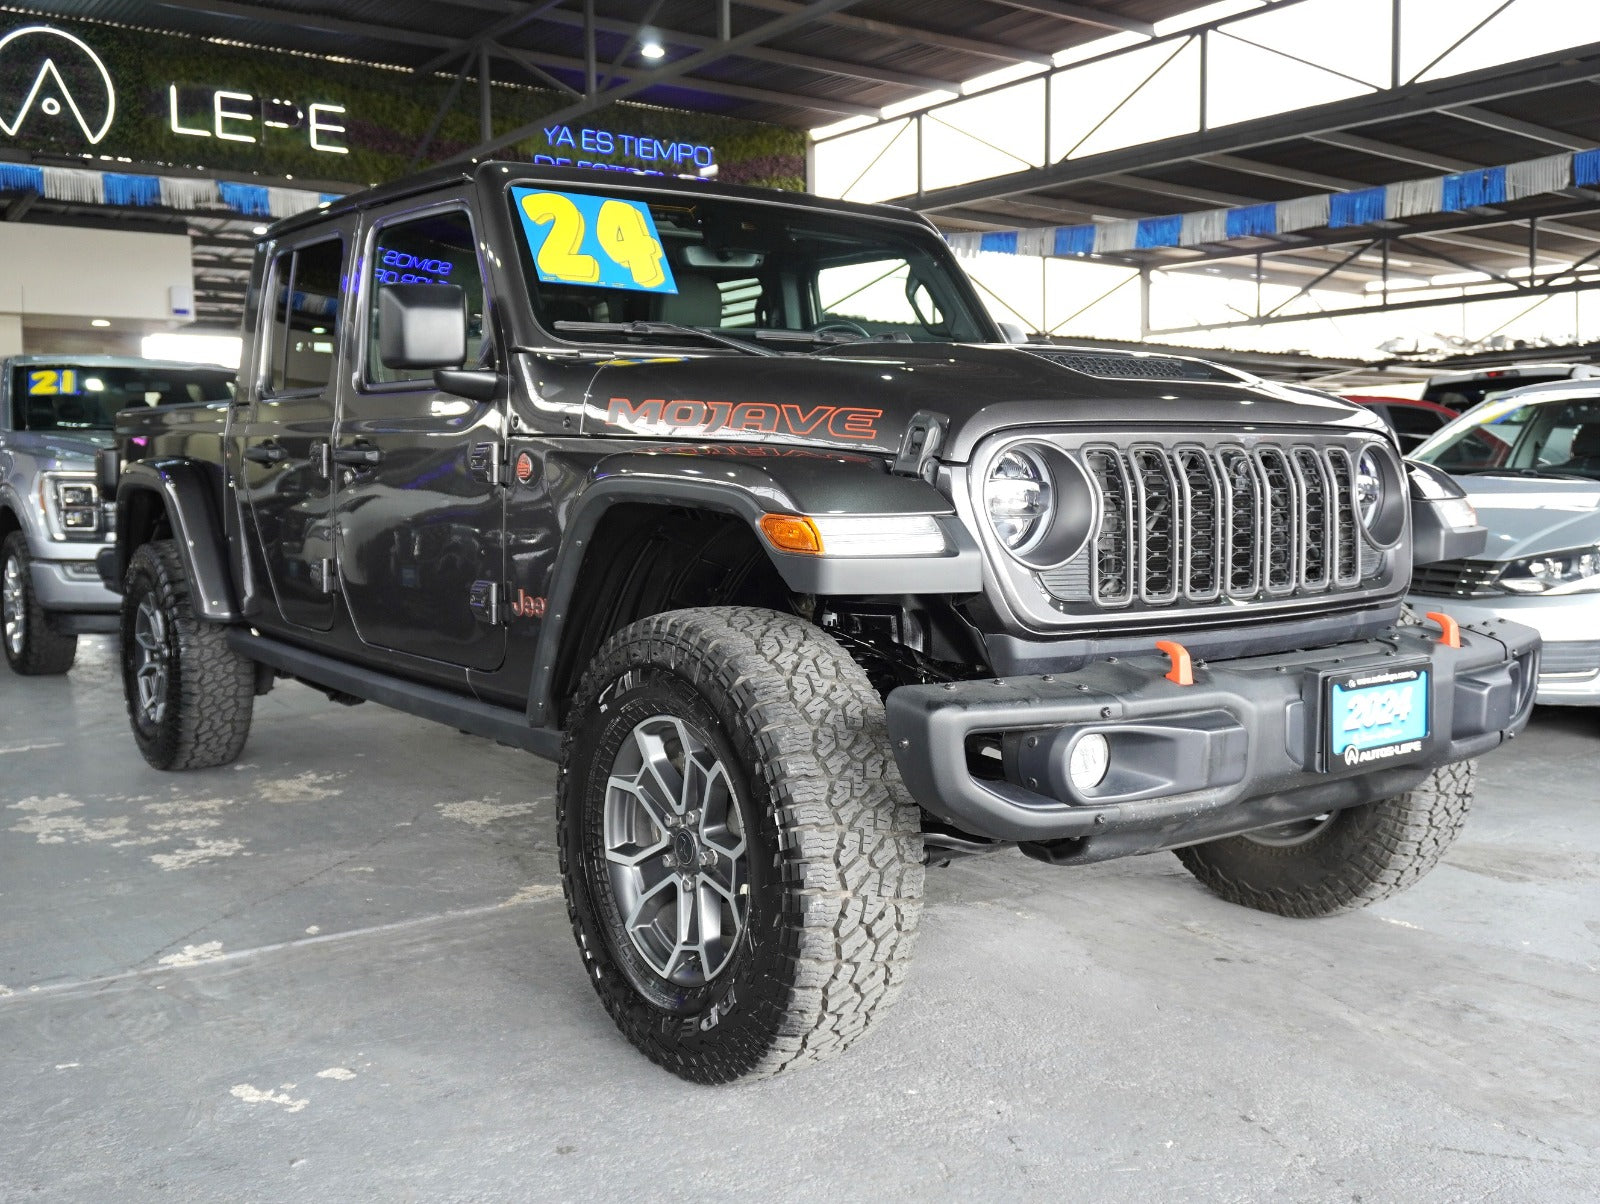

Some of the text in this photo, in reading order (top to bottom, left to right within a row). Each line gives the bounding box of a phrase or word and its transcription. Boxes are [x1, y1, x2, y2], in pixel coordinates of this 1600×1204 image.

[169, 81, 349, 154] LEPE
[543, 124, 713, 168] YA ES TIEMPO
[521, 193, 665, 288] 24
[29, 369, 77, 396] 21
[605, 397, 883, 440] MOJAVE
[511, 588, 548, 619] Jee
[1343, 685, 1414, 732] 2024
